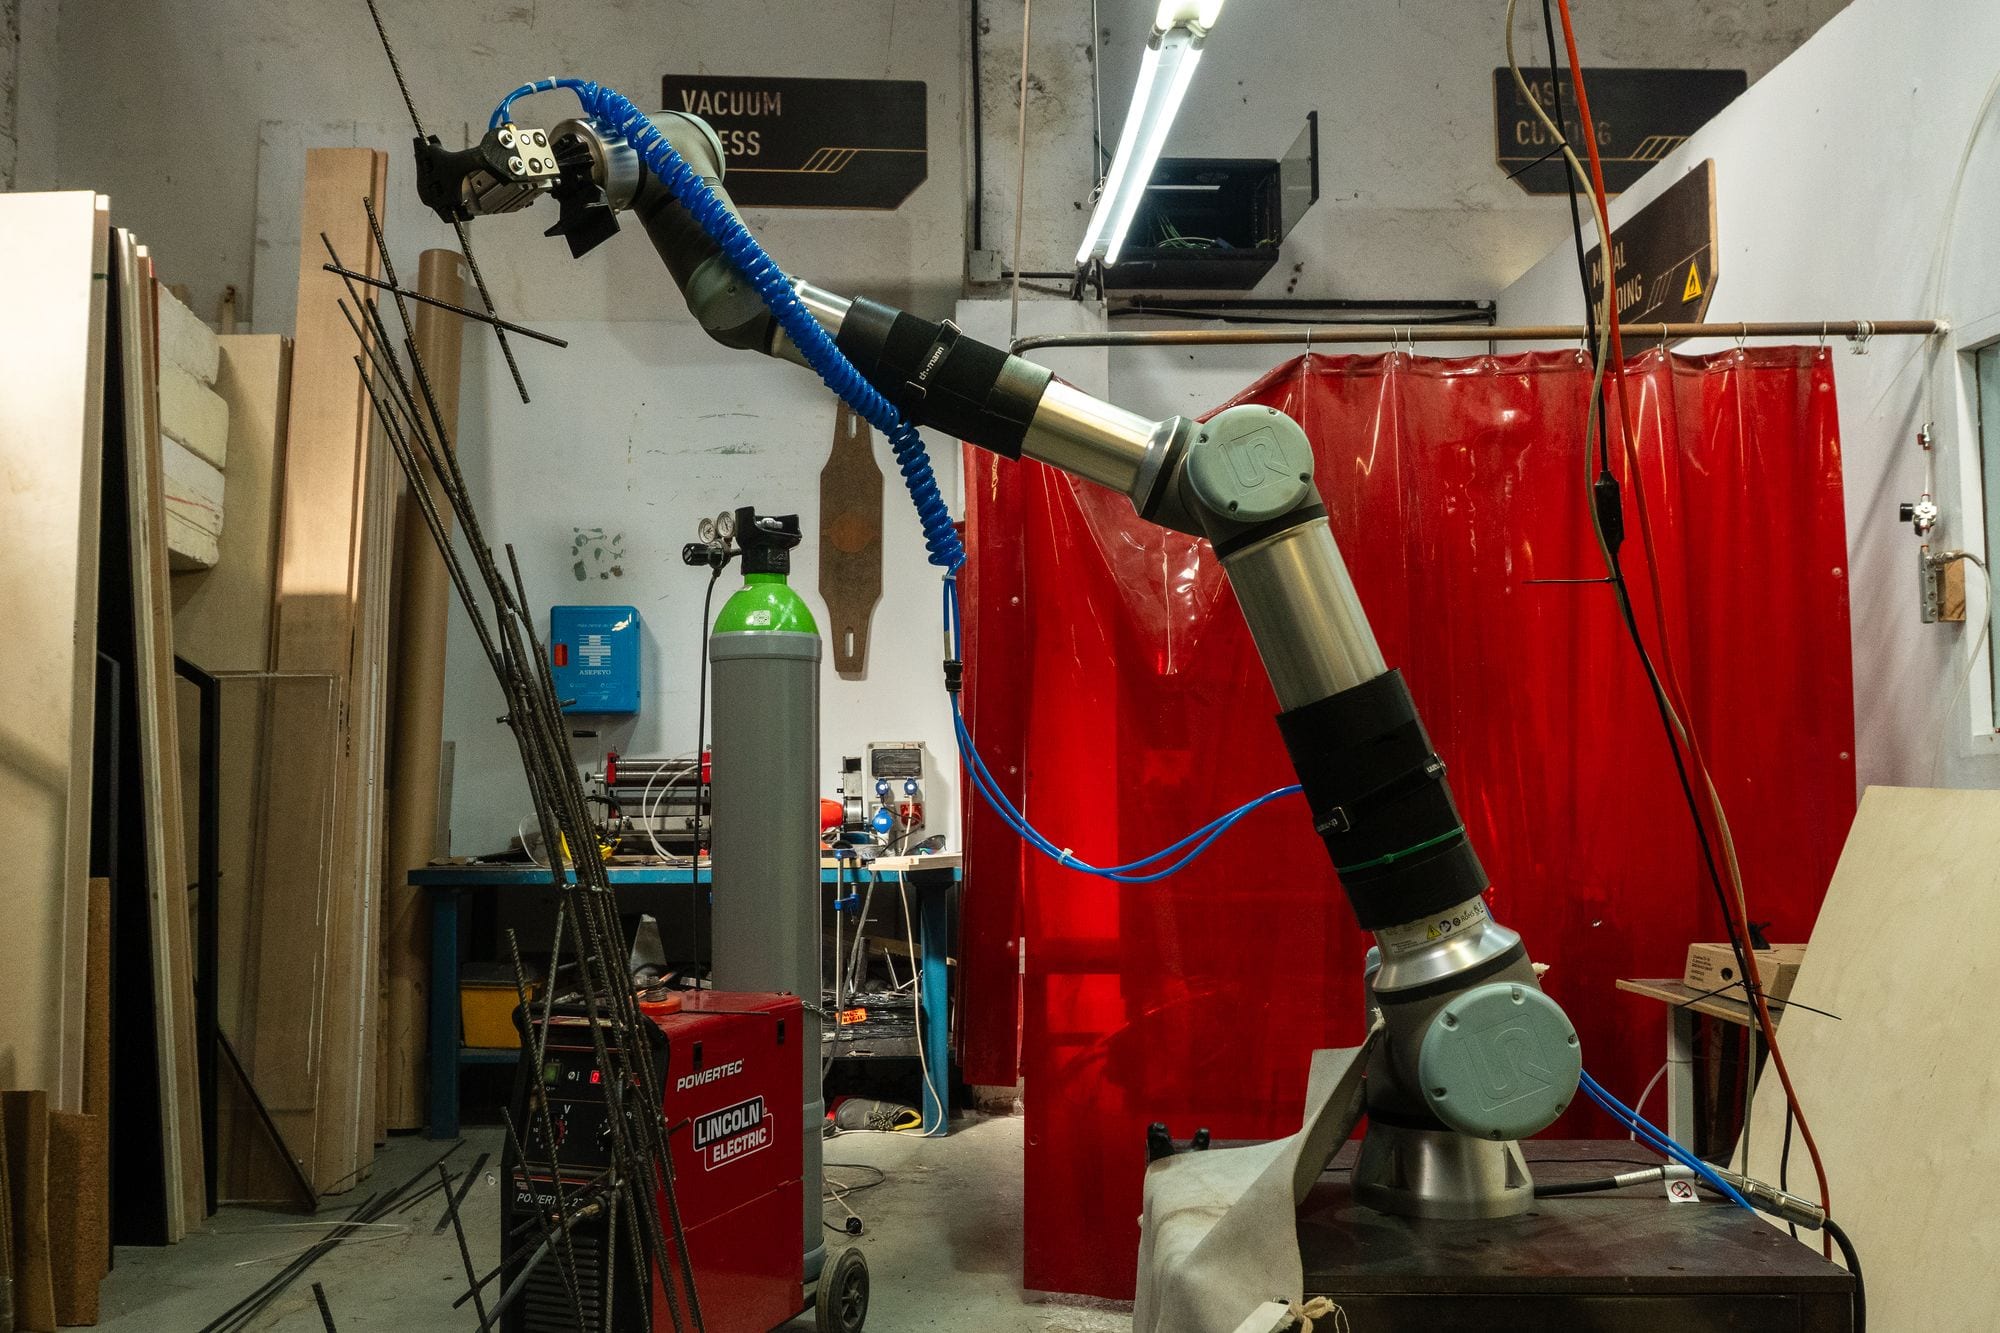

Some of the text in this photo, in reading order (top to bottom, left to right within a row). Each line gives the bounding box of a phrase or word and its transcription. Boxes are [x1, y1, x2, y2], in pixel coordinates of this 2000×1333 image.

[681, 90, 781, 116] VACUUM
[1592, 241, 1627, 289] MAL
[1593, 273, 1642, 326] WDING
[676, 1059, 745, 1093] POWERTEC
[697, 1102, 760, 1145] LINCOLN
[713, 1127, 767, 1163] ELECTRIC
